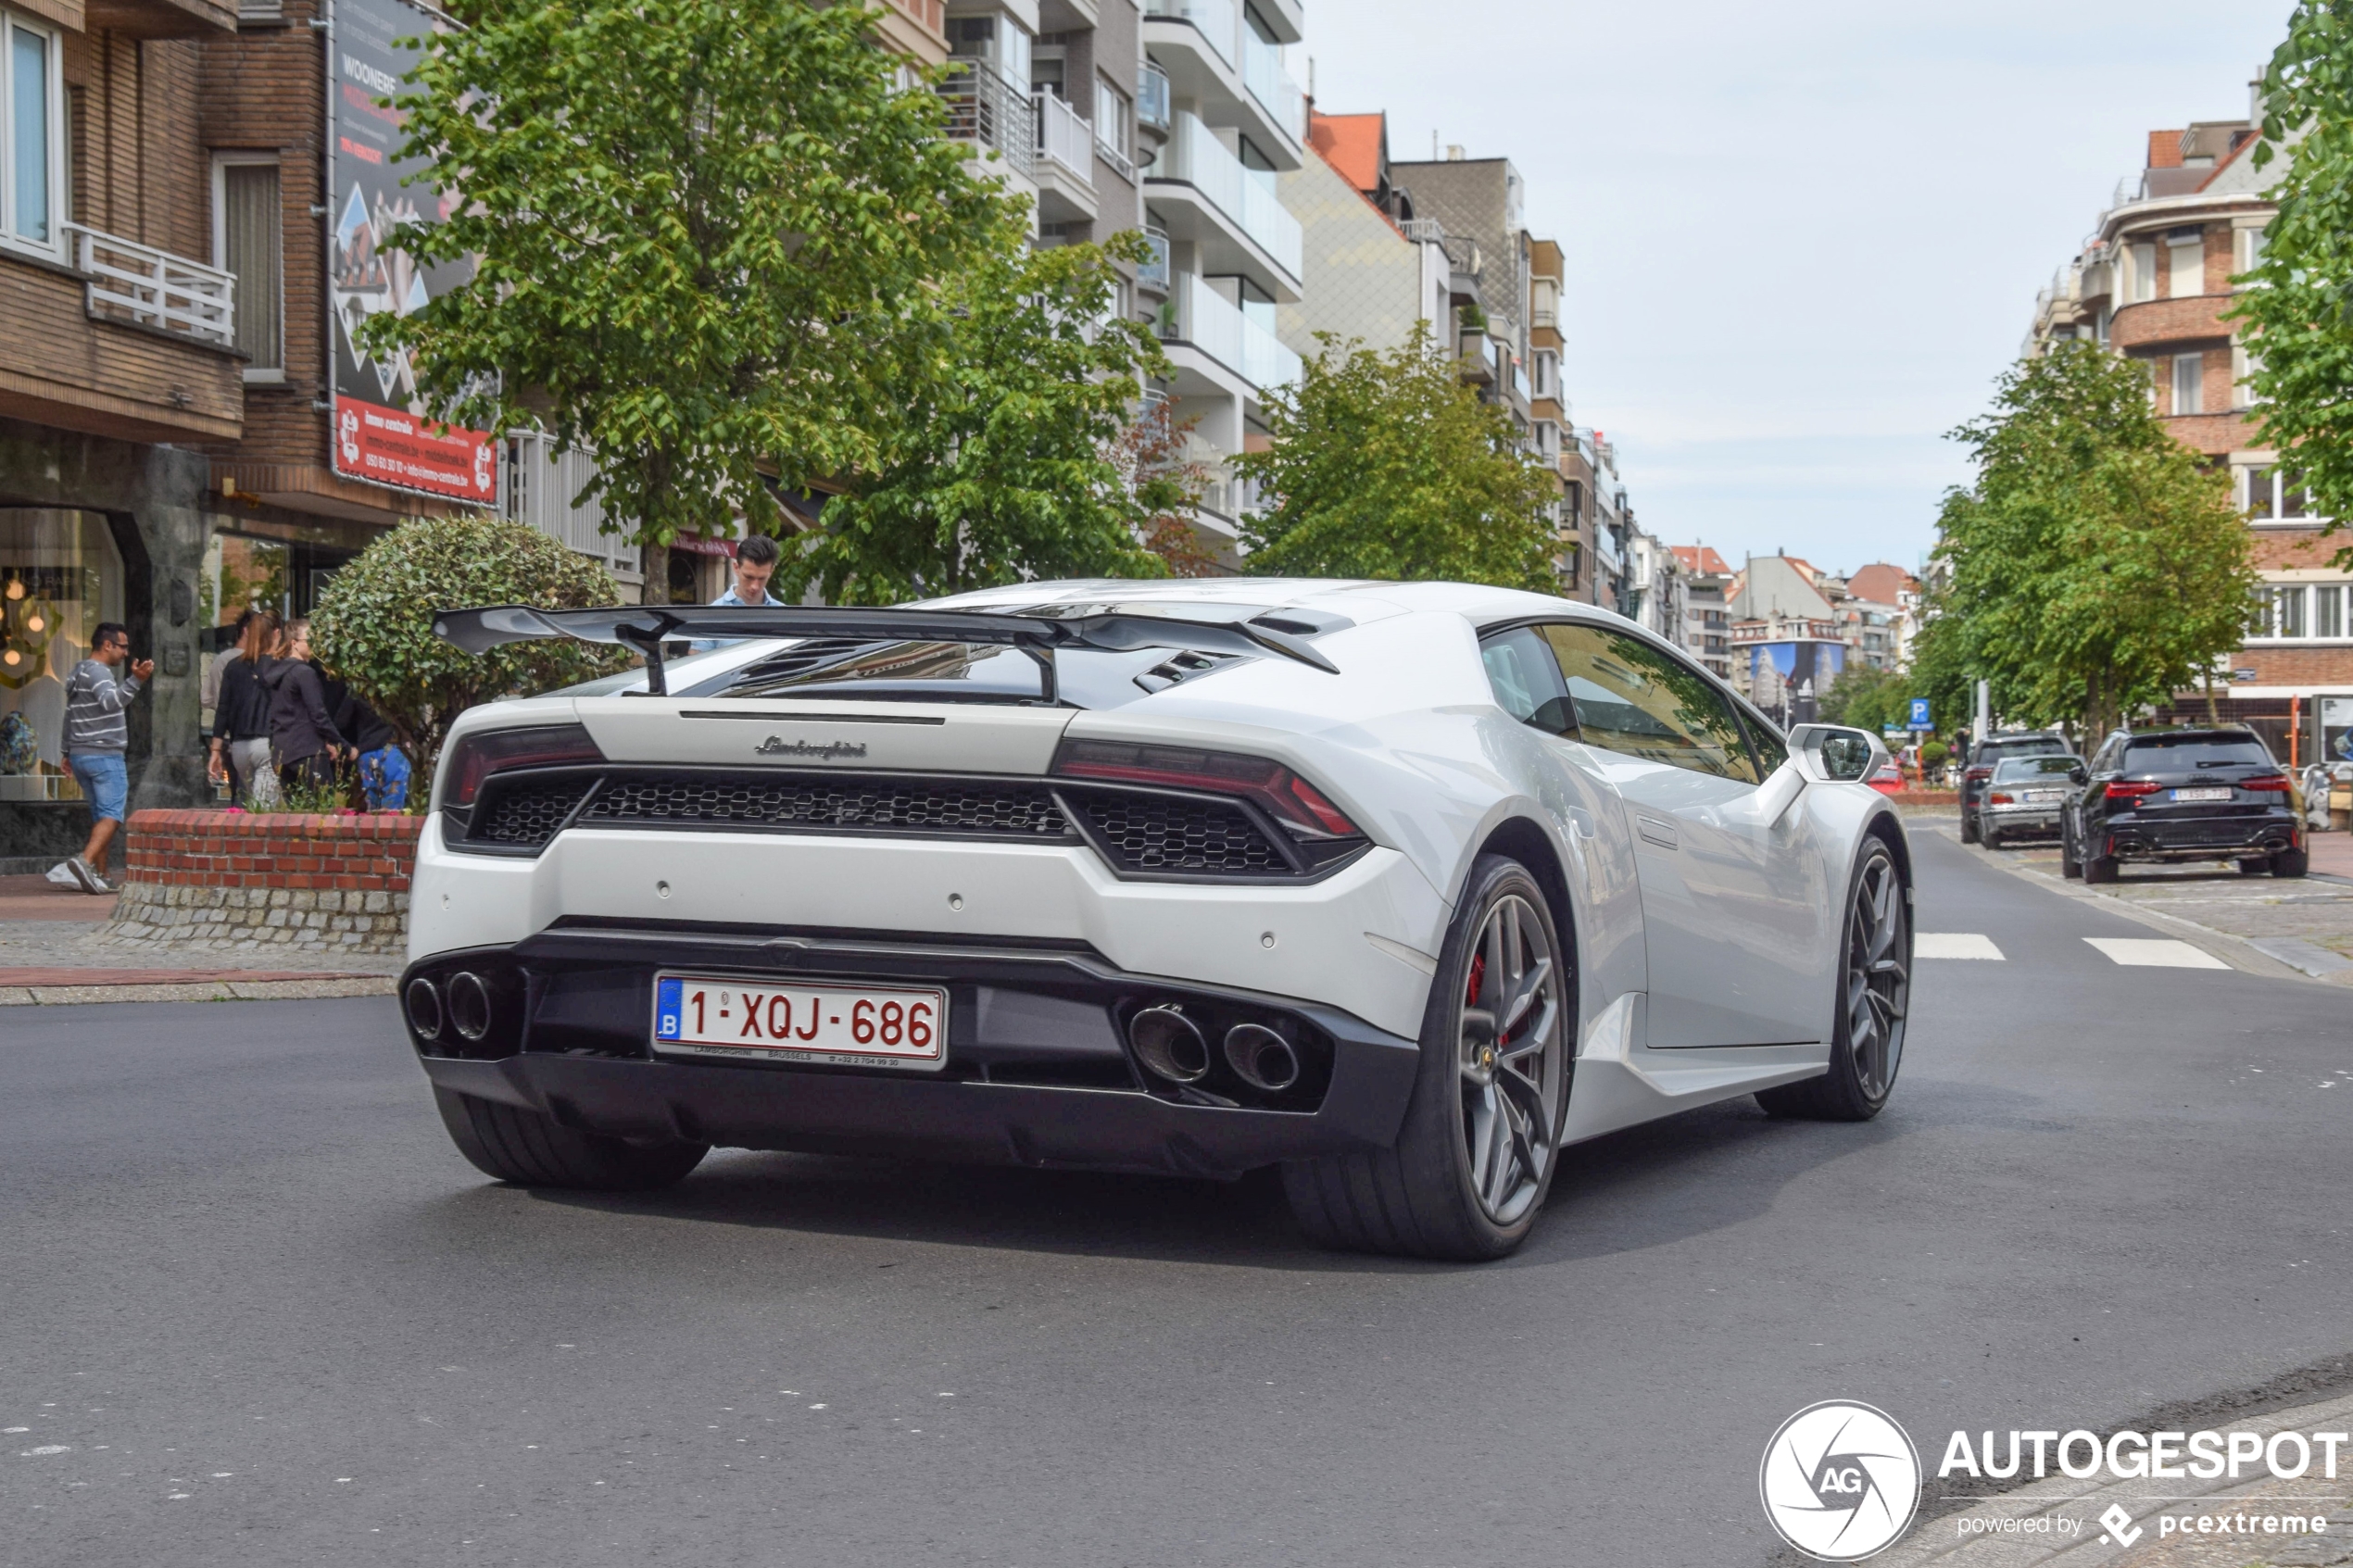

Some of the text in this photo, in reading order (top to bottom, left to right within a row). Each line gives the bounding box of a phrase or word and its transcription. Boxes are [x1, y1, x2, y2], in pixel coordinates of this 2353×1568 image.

[342, 53, 396, 96] WOONERF
[365, 410, 413, 435] immo centrale
[366, 453, 378, 467] 050
[379, 456, 387, 470] 60
[387, 458, 396, 472] 30
[396, 460, 403, 473] 10
[1913, 702, 1926, 720] P
[753, 735, 868, 761] Lamborghini
[661, 1014, 678, 1035] B
[691, 990, 933, 1047] 1-XQJ-686
[694, 1047, 752, 1057] LAMBORGHINI
[768, 1050, 812, 1060] BRUSSELS
[837, 1056, 852, 1064] +32
